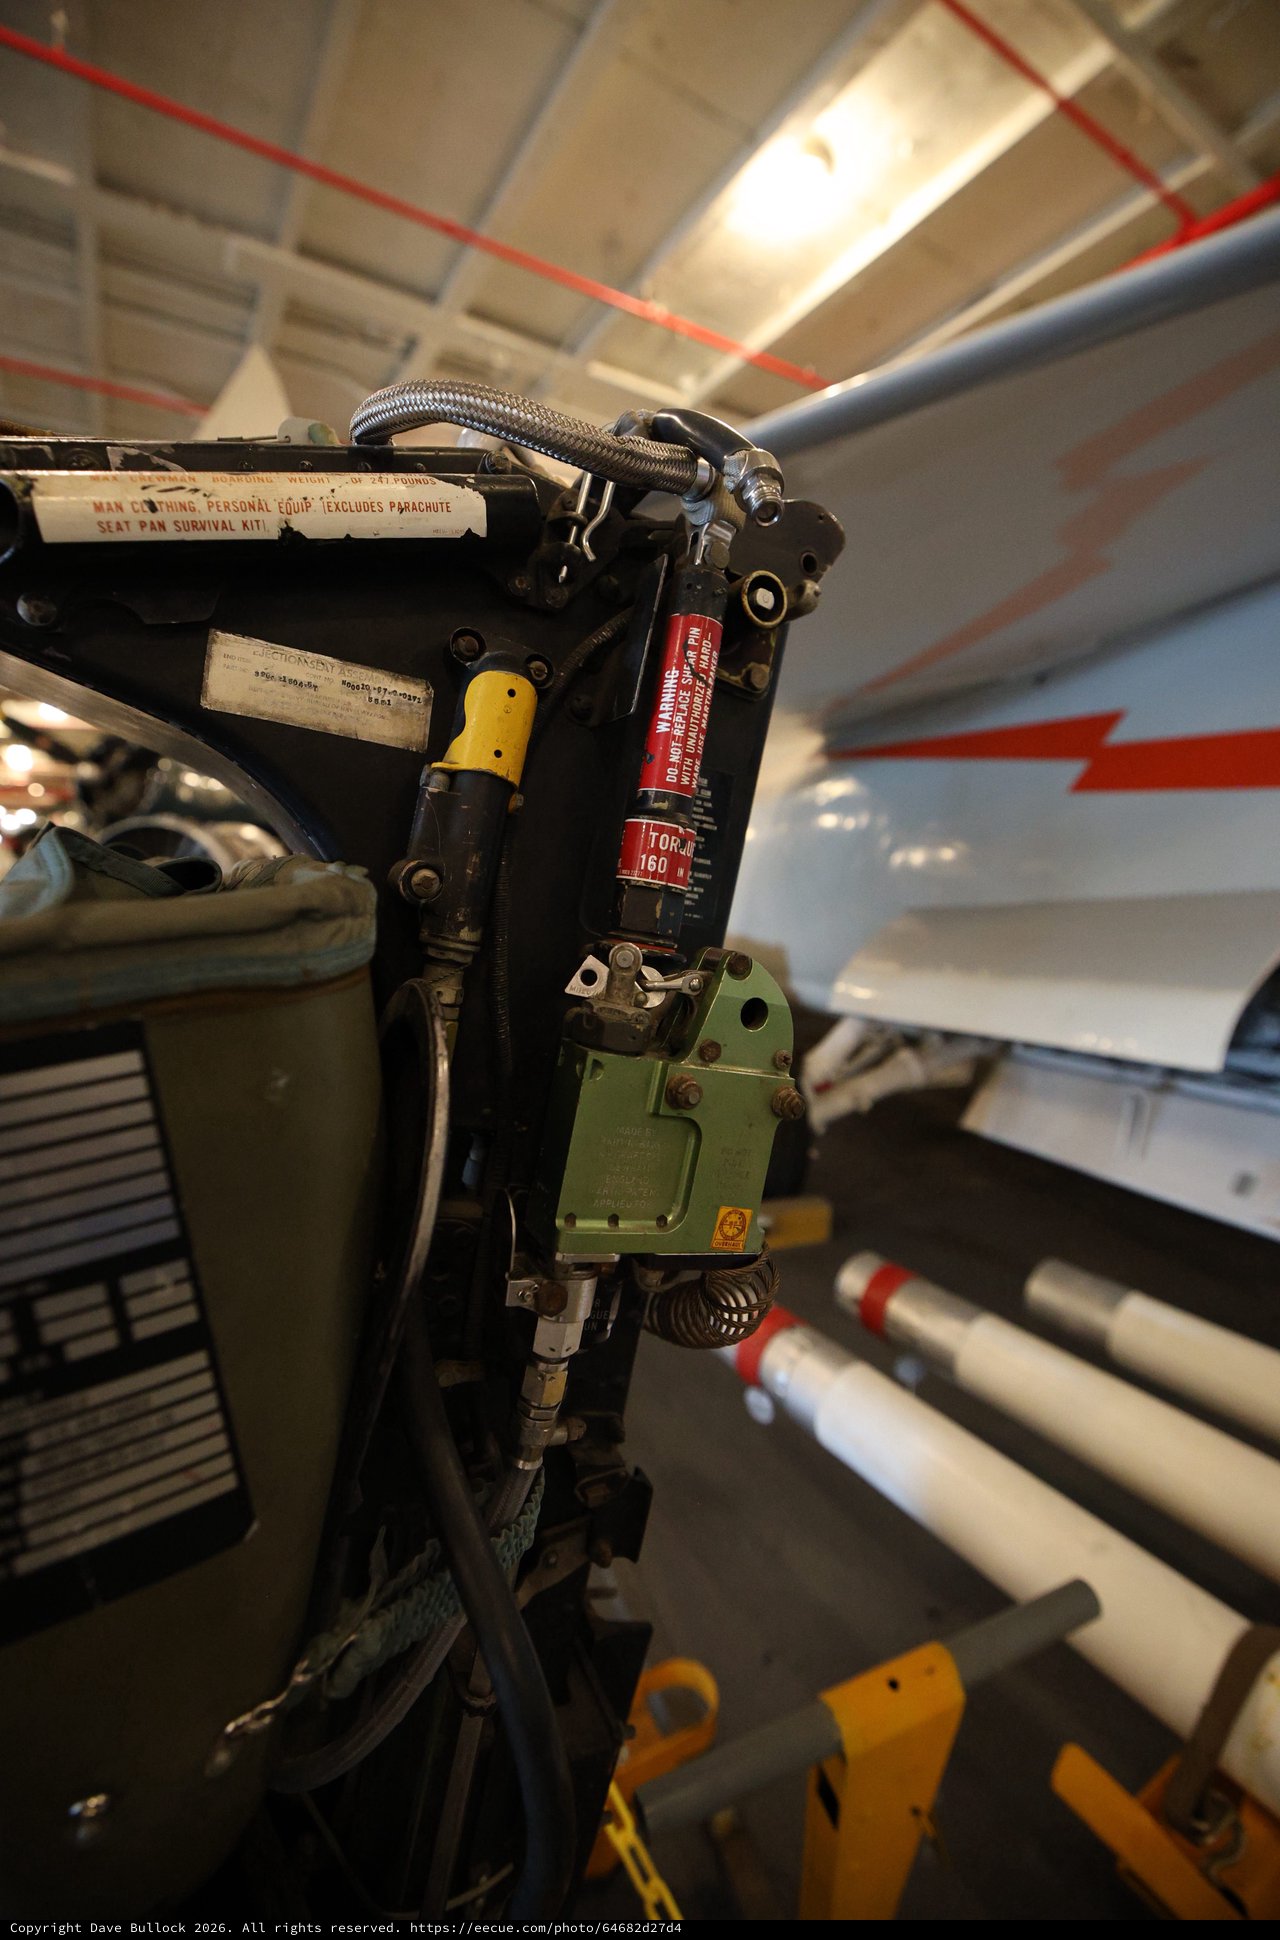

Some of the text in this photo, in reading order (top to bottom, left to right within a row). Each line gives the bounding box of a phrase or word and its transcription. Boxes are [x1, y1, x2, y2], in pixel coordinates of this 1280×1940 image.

[211, 475, 273, 484] BOARDING
[287, 476, 330, 484] WEIGHT
[350, 477, 364, 485] OF
[394, 477, 437, 486] POUNDS
[93, 500, 124, 514] MAN
[130, 500, 201, 514] CLTHING,
[207, 500, 272, 513] PERSONAL
[323, 501, 384, 514] (EXCLUDES
[389, 501, 452, 514] PARACHUTE
[97, 520, 131, 534] SEAT
[139, 520, 167, 533] PAN
[173, 519, 236, 533] SURVIVAL
[252, 648, 307, 667] EJECTION
[309, 659, 336, 674] SEAT
[656, 669, 679, 734] WARNING
[666, 626, 701, 783] DO NOT REPLACE SHEAR PIN
[680, 757, 693, 785] WITH
[691, 758, 701, 789] WARE
[697, 733, 706, 755] USE
[640, 853, 668, 874] 160
[677, 867, 685, 878] IN
